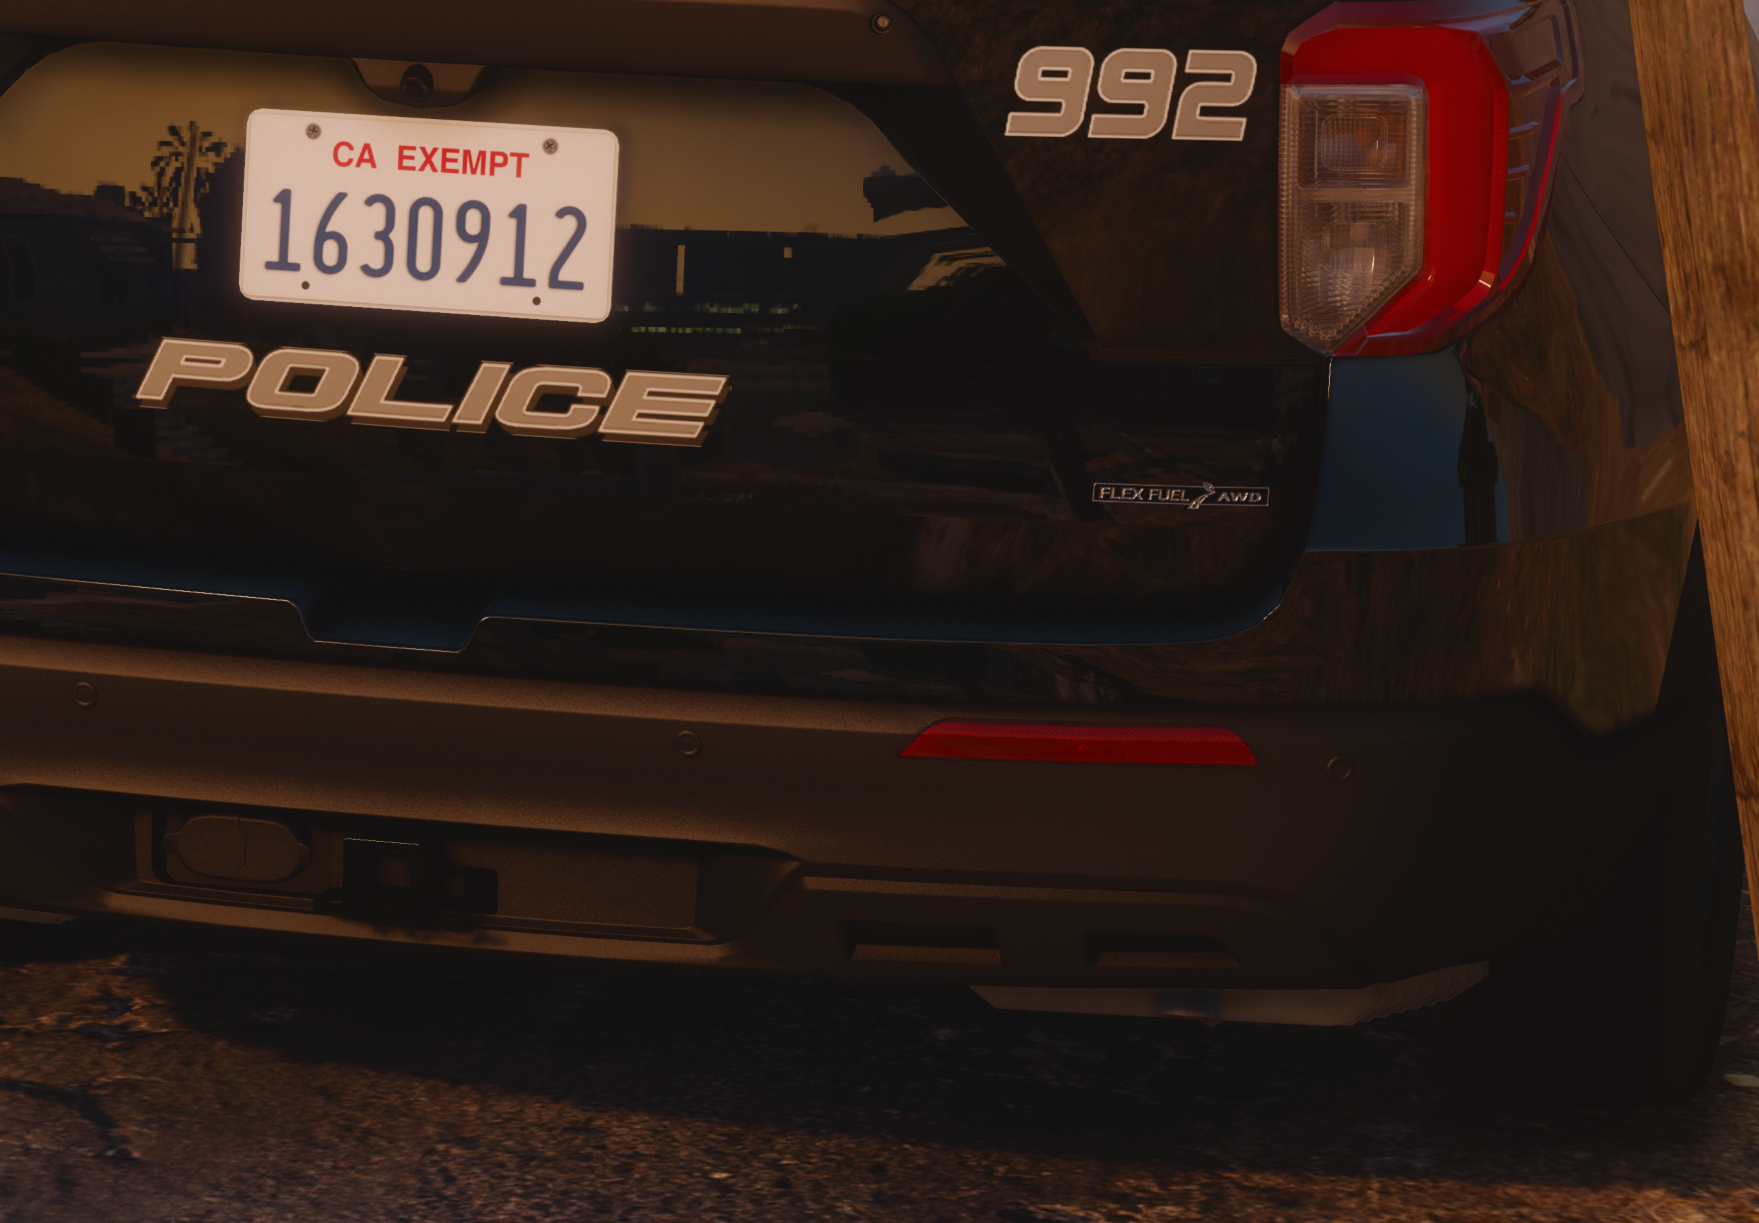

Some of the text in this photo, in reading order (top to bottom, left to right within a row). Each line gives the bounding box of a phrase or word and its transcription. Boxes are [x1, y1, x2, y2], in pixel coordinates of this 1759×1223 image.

[1004, 45, 1258, 141] 992
[331, 141, 530, 179] CA EXEMPT
[264, 187, 588, 291] 1630912
[135, 336, 731, 446] POLICE
[1099, 486, 1262, 503] FLEX FUEL AWD
